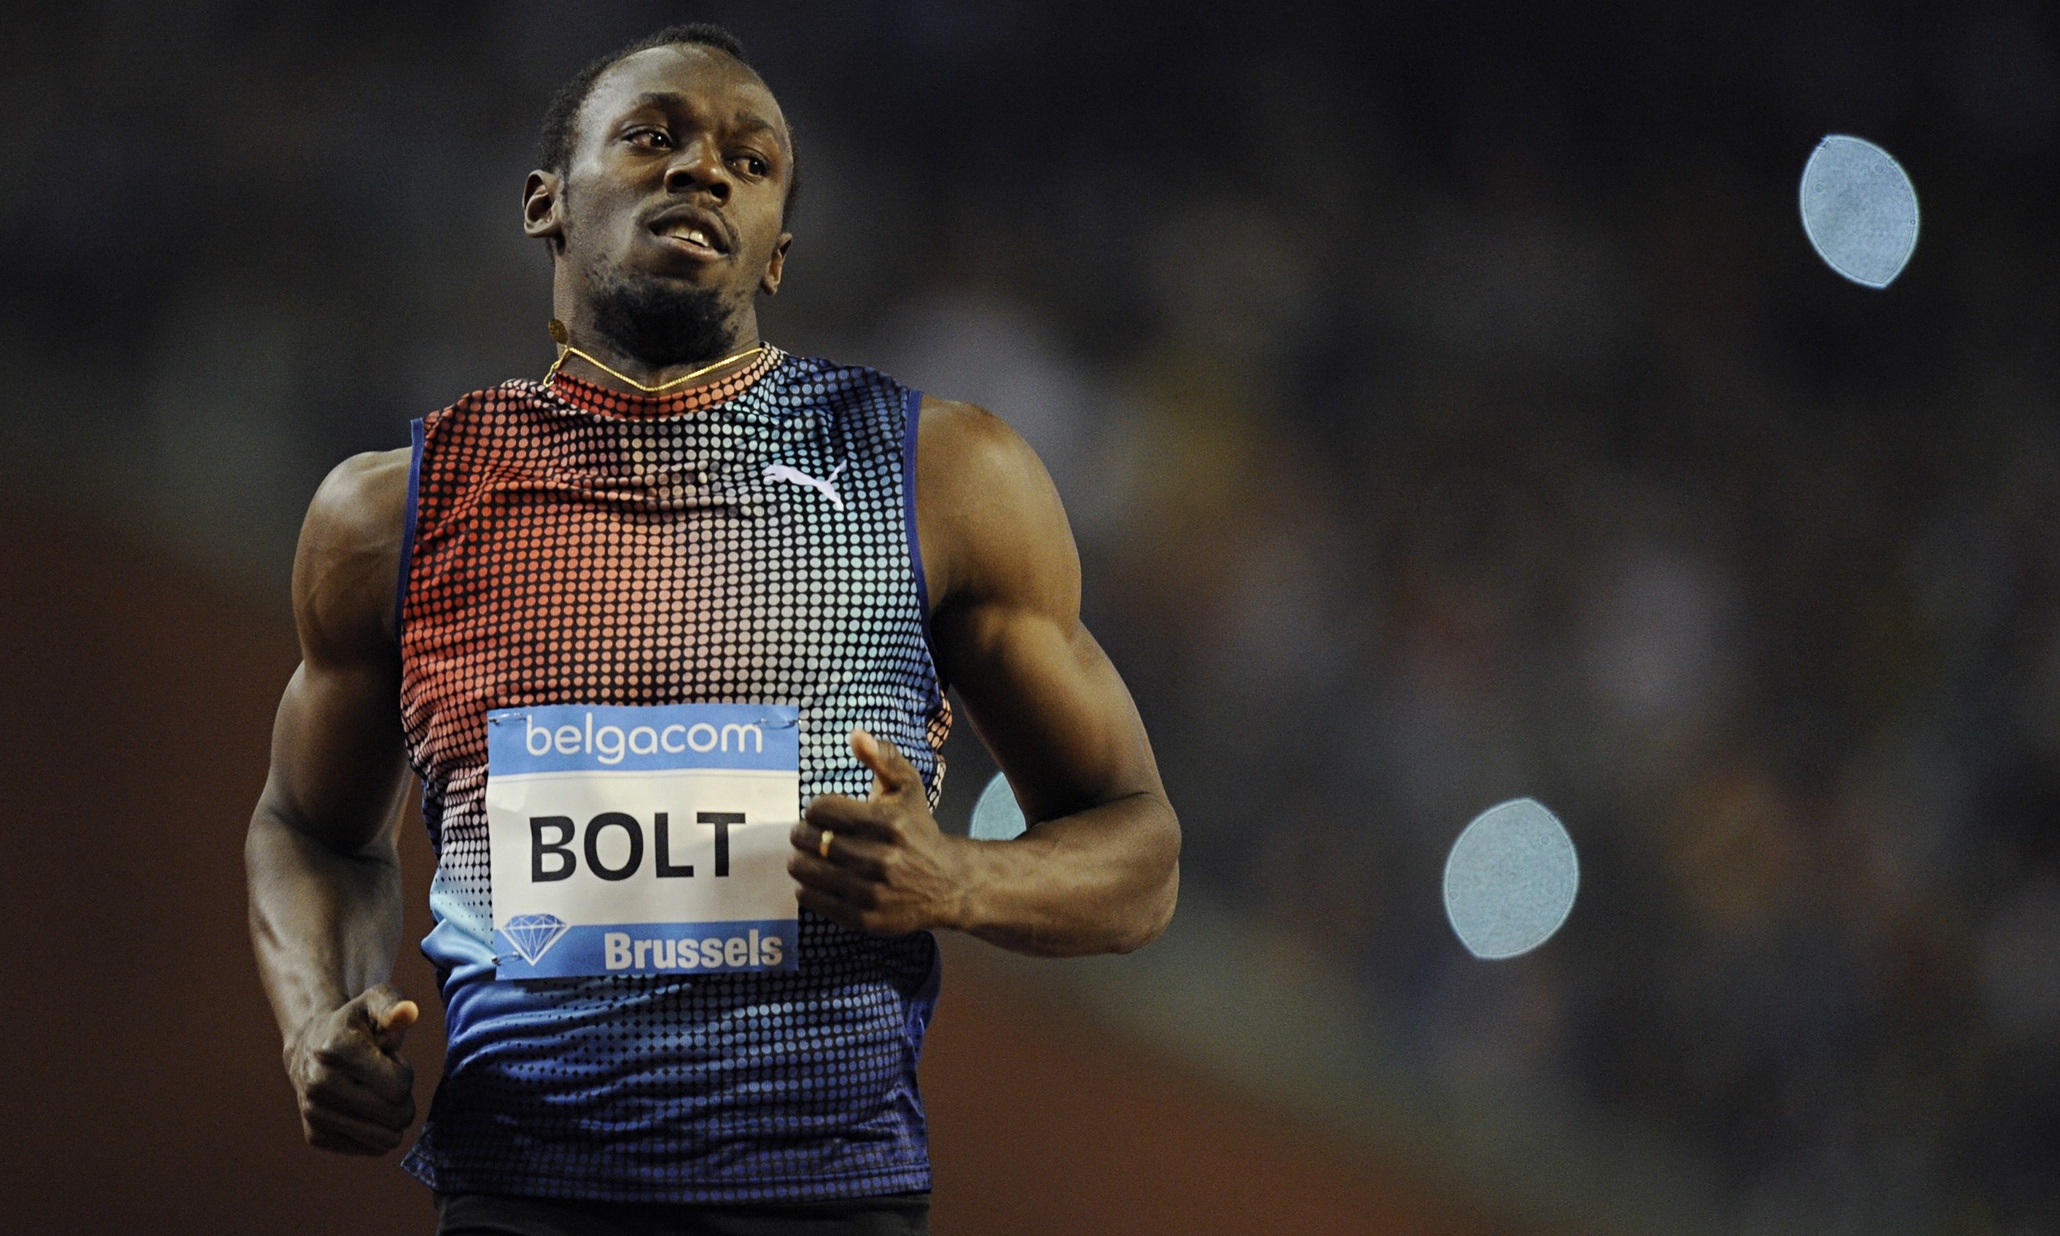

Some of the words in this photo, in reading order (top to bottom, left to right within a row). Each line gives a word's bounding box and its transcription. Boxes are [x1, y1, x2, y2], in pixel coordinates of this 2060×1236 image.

[525, 712, 763, 765] belgacom
[529, 811, 746, 883] BOLT
[604, 929, 783, 971] Brussels
